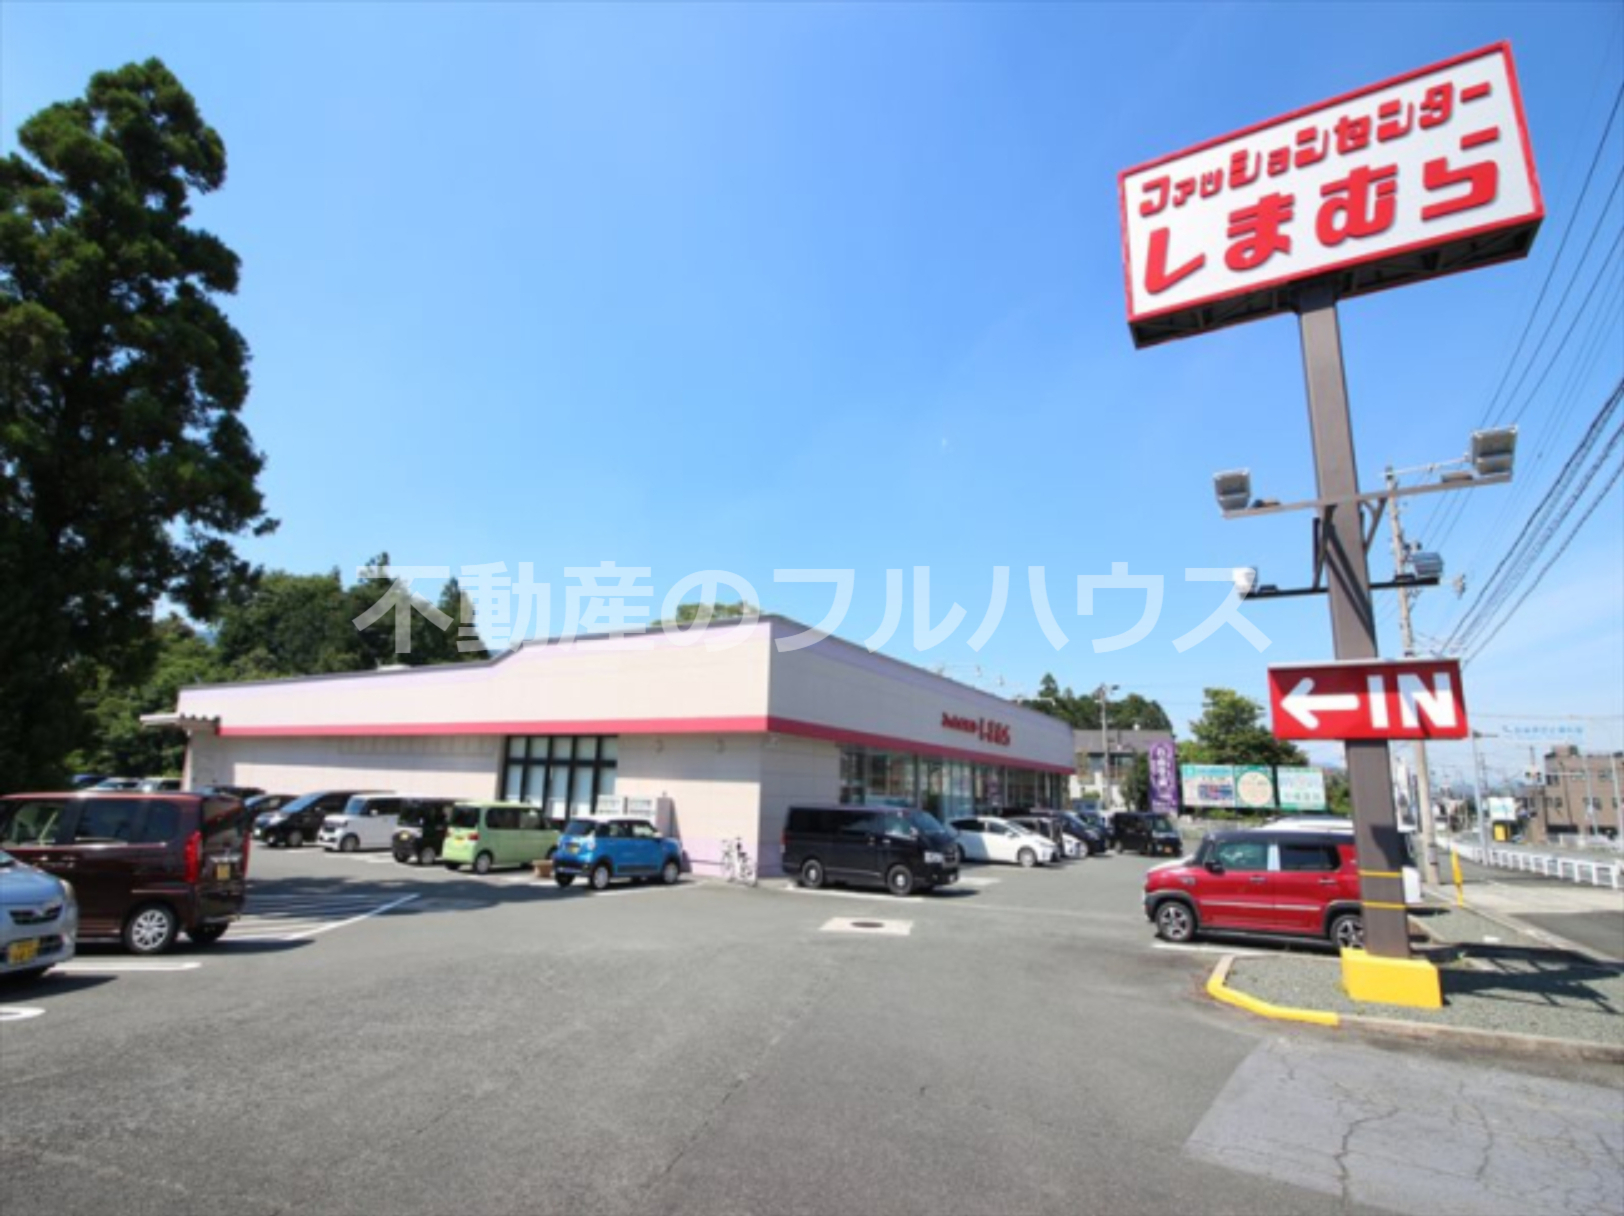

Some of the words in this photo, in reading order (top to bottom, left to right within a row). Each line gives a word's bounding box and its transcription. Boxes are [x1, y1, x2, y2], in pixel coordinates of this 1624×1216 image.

[1139, 81, 1492, 216] ファッションセンター
[1144, 126, 1500, 294] しまむら
[1367, 672, 1457, 729] IN
